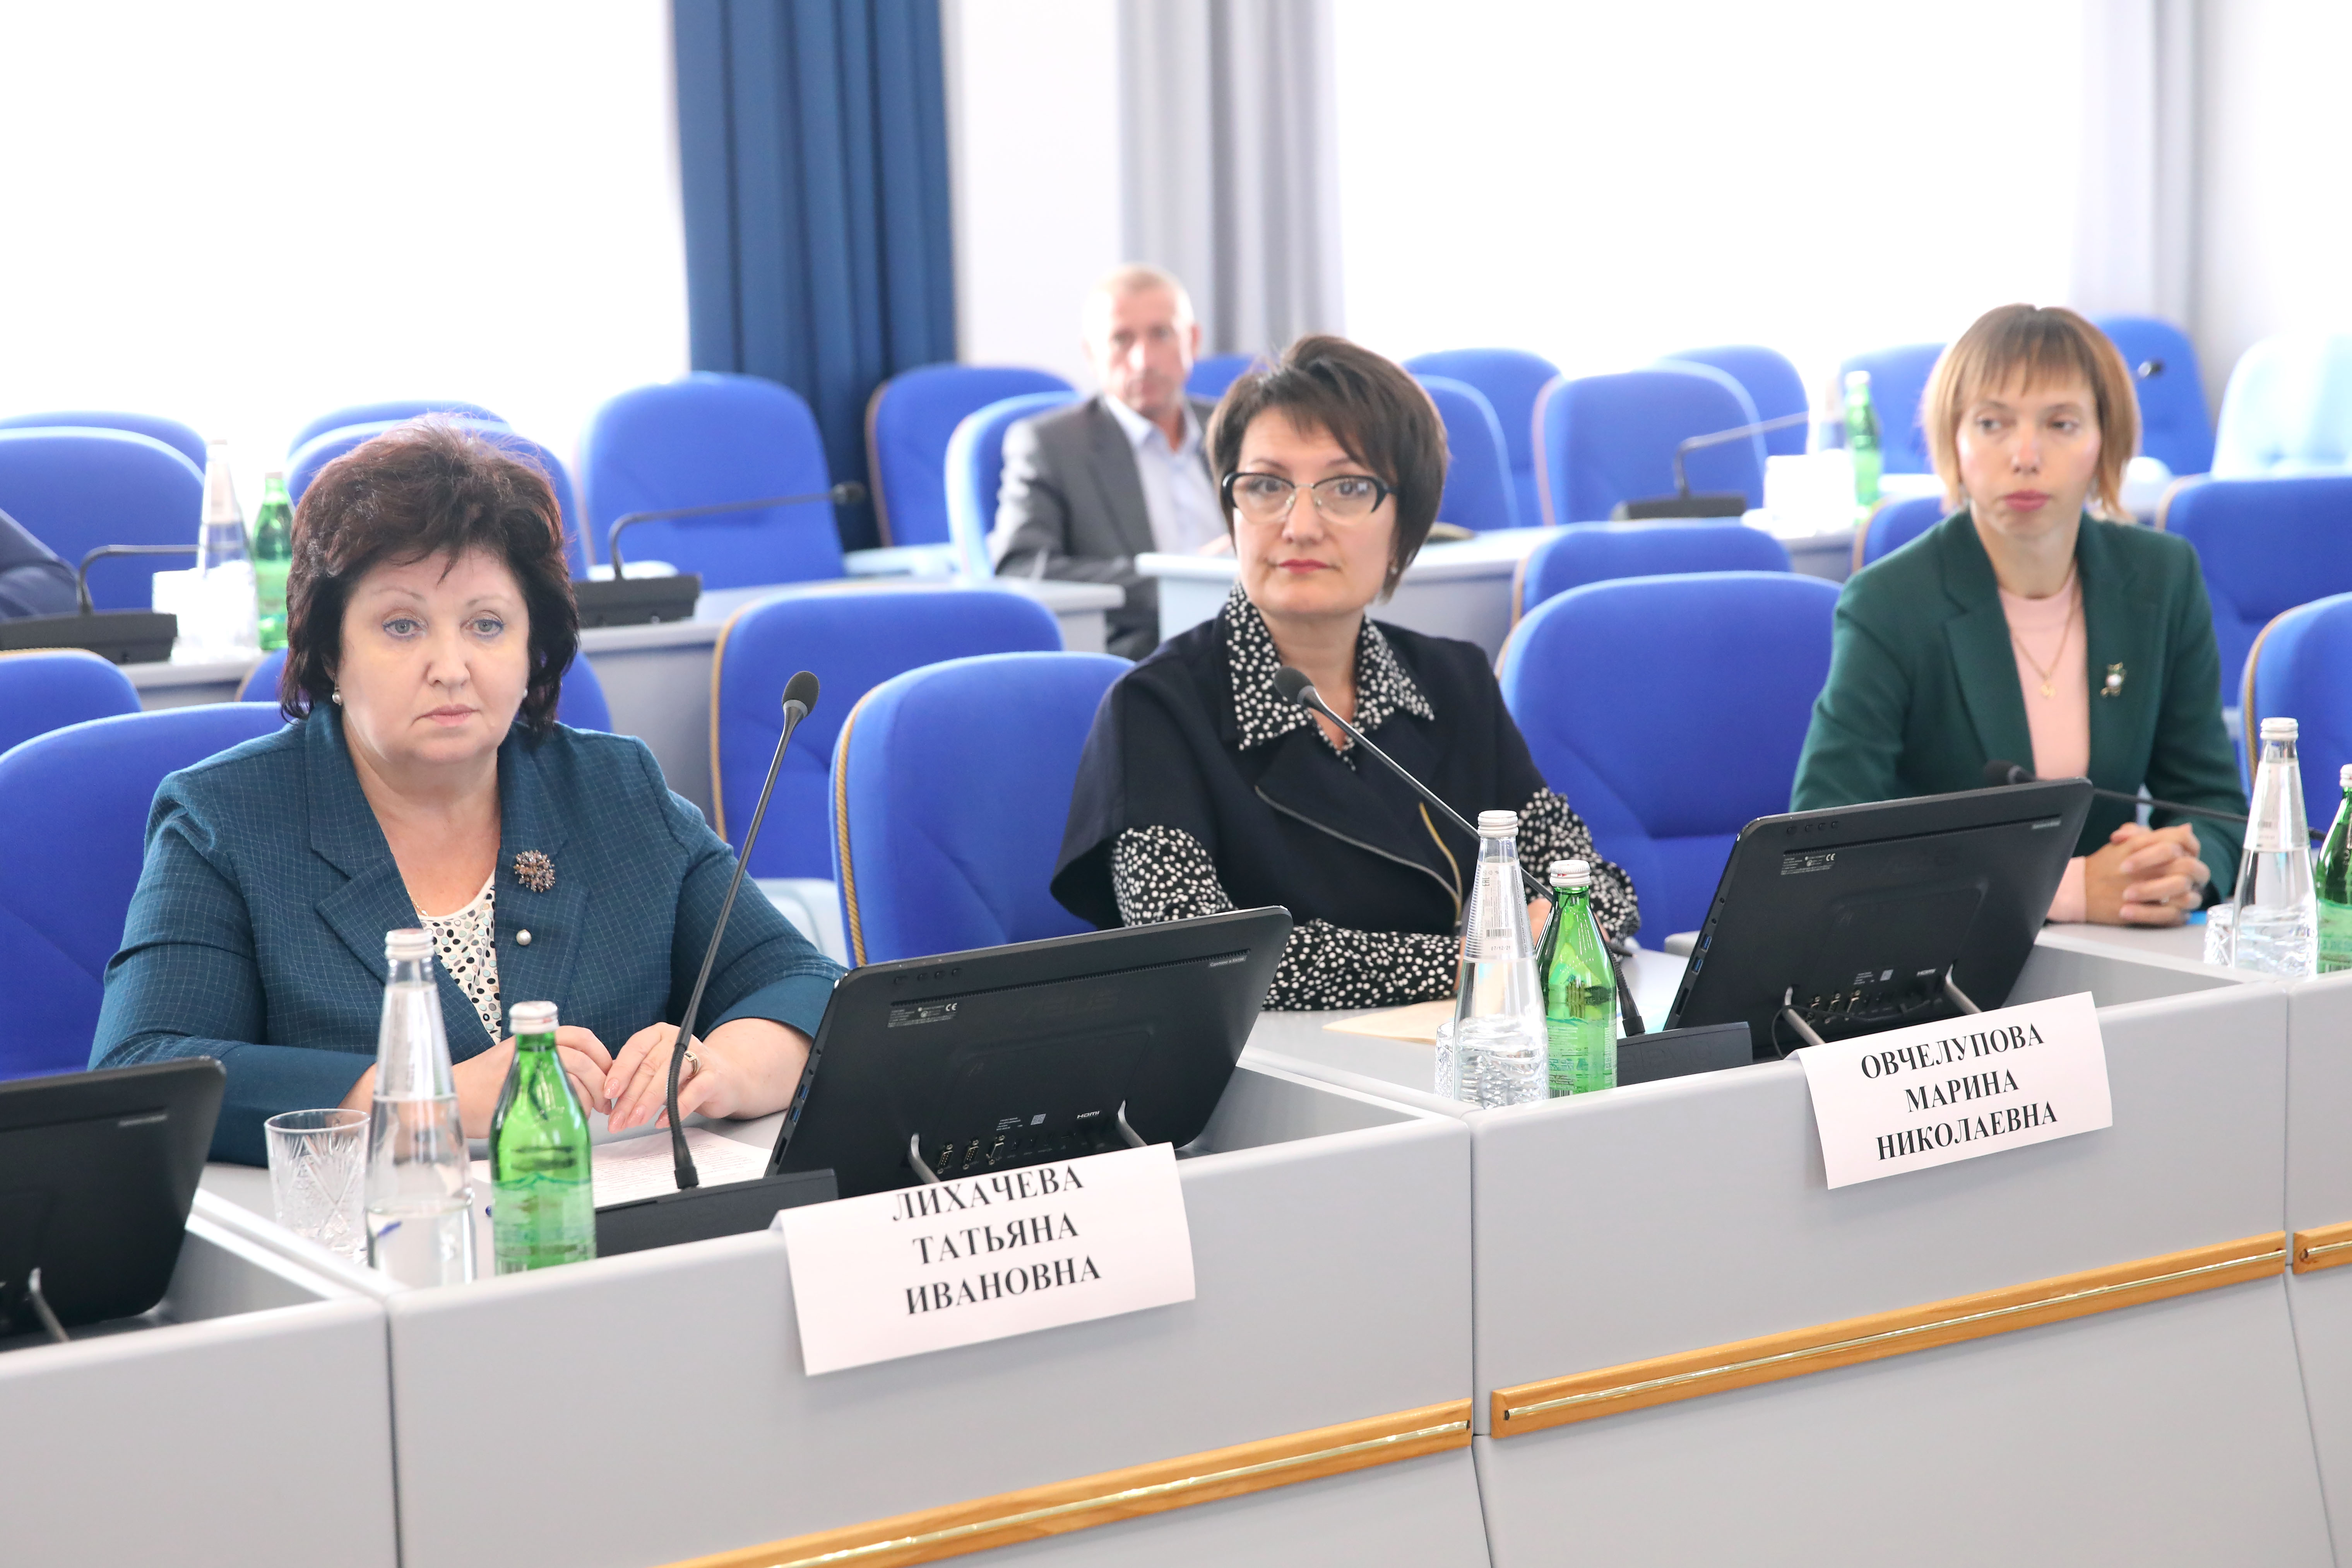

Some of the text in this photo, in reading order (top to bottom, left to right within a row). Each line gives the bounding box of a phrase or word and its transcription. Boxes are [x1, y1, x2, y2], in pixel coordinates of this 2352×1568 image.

[1861, 1022, 2045, 1079] ОВЧЕЛУПОВА
[1077, 1110, 1100, 1119] HDMI
[1904, 1068, 2020, 1112] МАРИНА
[1876, 1100, 2058, 1161] НИКОЛАЕВНА
[892, 1165, 1085, 1222] ЛИХАЧЕВА
[912, 1212, 1079, 1265] ТАТЬЯНА
[905, 1255, 1102, 1315] ИВАНОВНА
